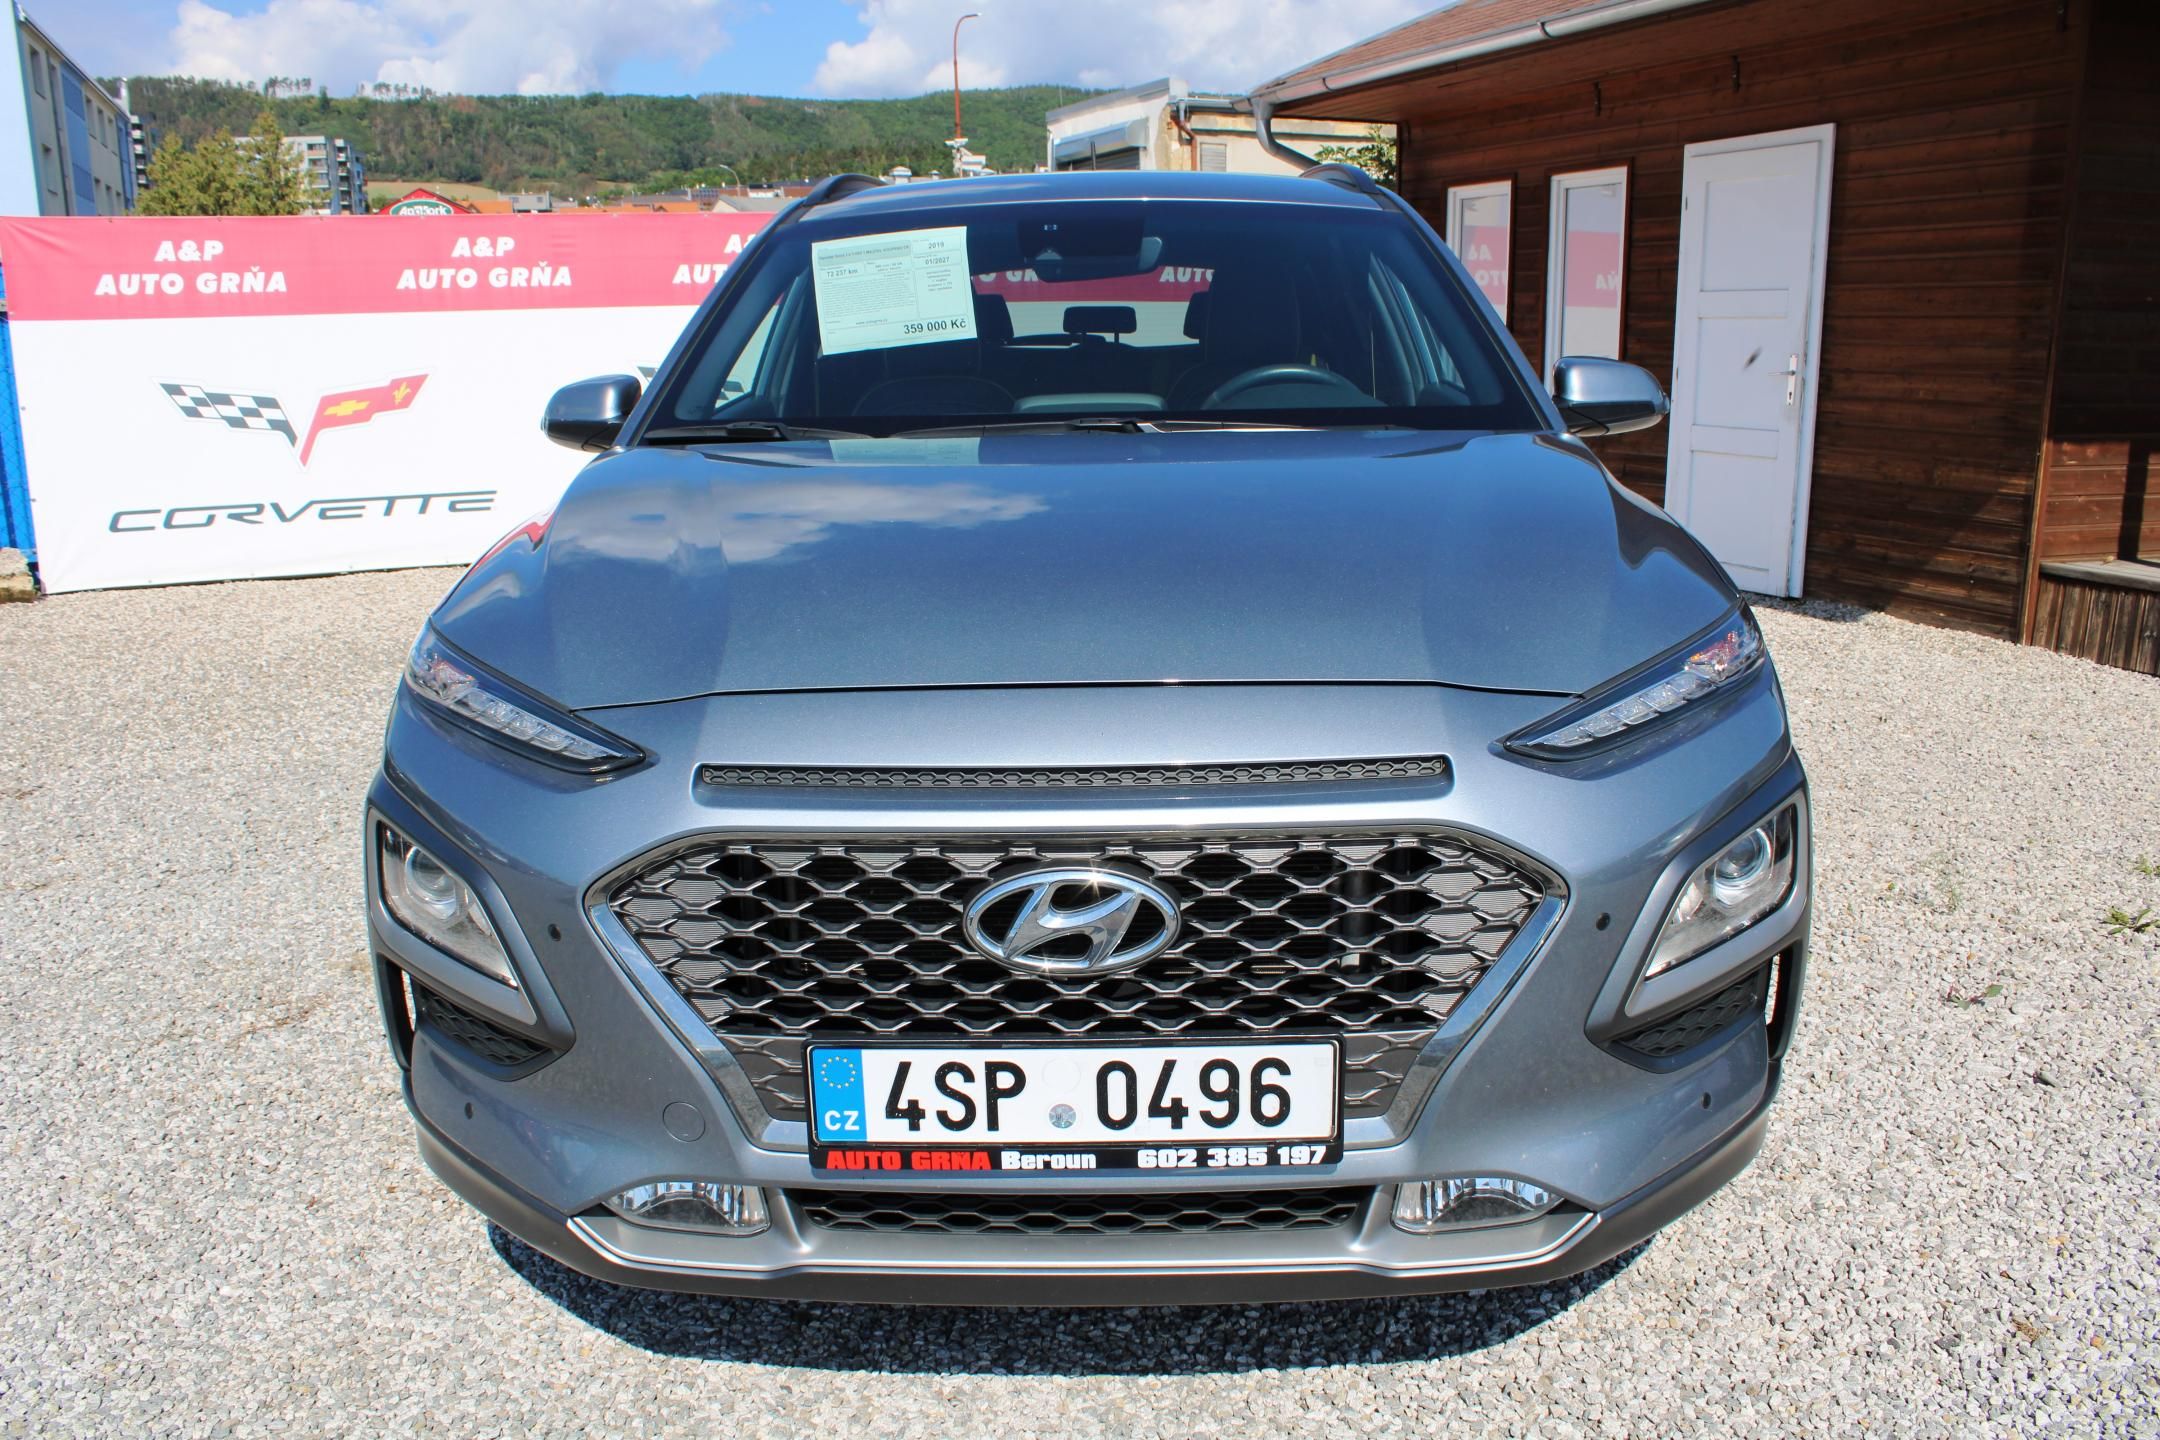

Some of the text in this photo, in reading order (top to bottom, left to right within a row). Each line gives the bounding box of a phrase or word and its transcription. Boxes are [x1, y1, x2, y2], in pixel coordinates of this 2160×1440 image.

[154, 240, 224, 262] A&P
[451, 236, 515, 257] A&P
[95, 265, 287, 296] AUTO GRŇA
[396, 260, 572, 289] AUTO GRŇA
[672, 264, 729, 284] AUT
[903, 318, 967, 335] 359 000 Kč
[108, 490, 498, 533] CORVETTE
[885, 1057, 1292, 1132] 4SP 0496
[824, 1110, 860, 1131] CZ
[826, 1151, 902, 1170] AUTO
[1001, 1151, 1097, 1170] Beroun
[1137, 1149, 1198, 1168] 602
[1207, 1147, 1268, 1168] 385
[1277, 1145, 1327, 1166] 197
